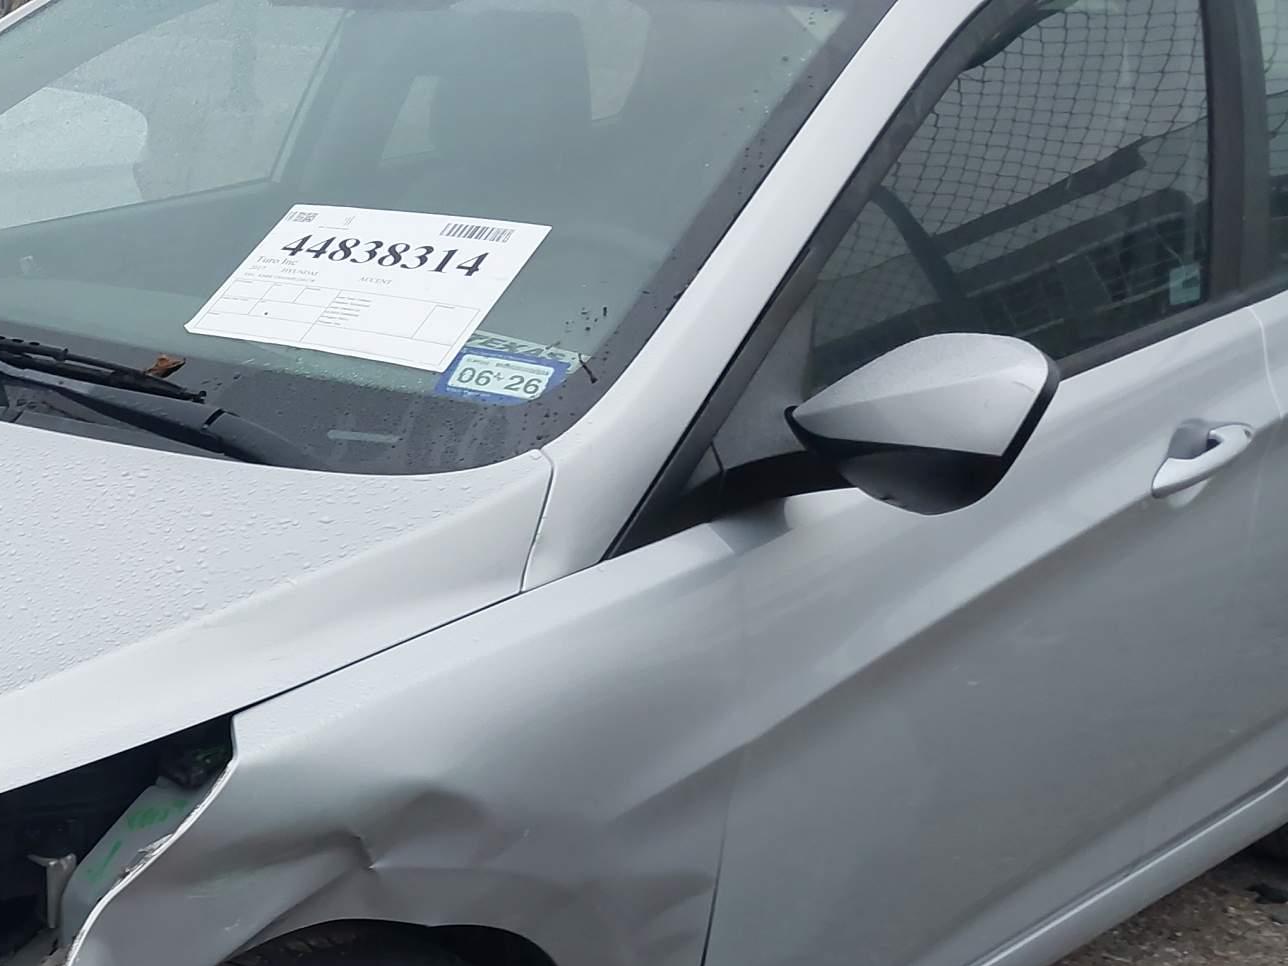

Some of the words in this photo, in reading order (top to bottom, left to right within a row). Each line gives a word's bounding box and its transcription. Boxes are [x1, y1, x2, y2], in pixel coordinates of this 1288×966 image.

[281, 234, 491, 277] 44838314
[281, 257, 299, 266] Inc
[456, 367, 494, 386] 06
[503, 375, 543, 395] 26
